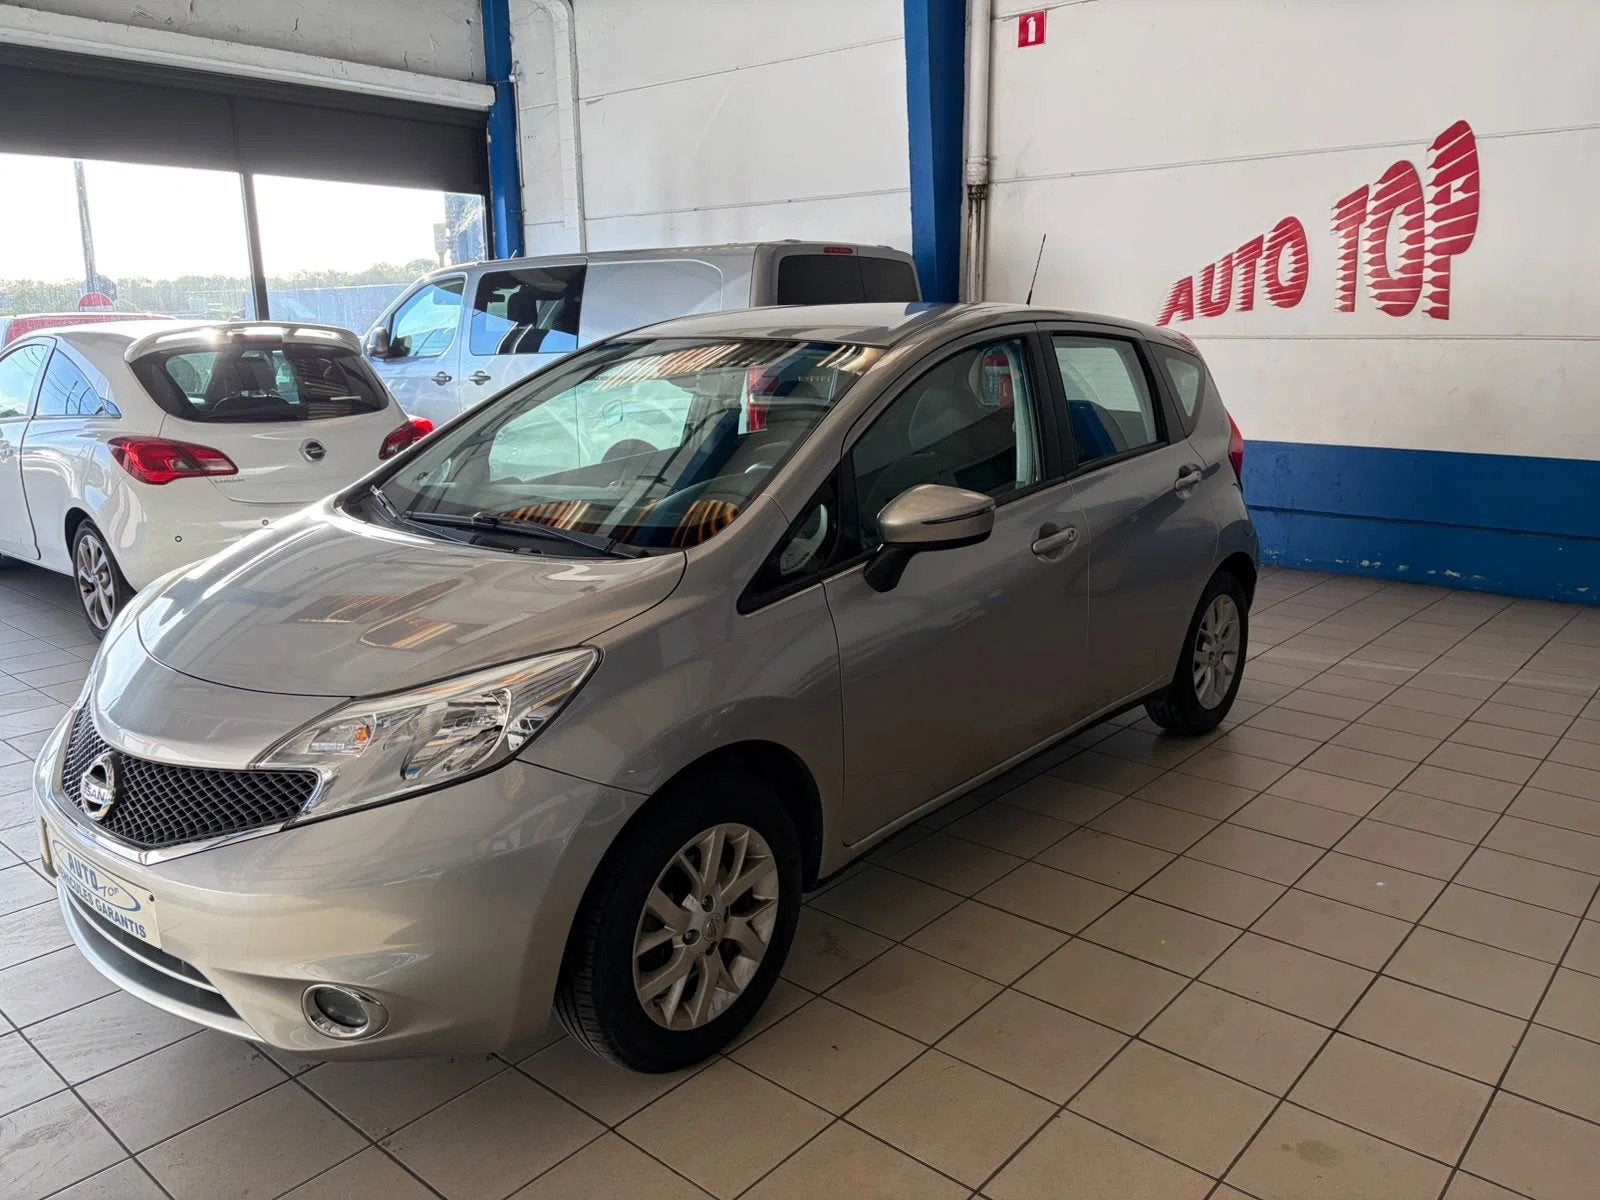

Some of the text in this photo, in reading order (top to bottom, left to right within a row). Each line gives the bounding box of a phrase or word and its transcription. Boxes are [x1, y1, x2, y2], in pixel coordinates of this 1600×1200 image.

[1154, 119, 1480, 327] AUTO TOP
[67, 852, 119, 897] AUTO TOP
[95, 898, 147, 938] GARANTIS
